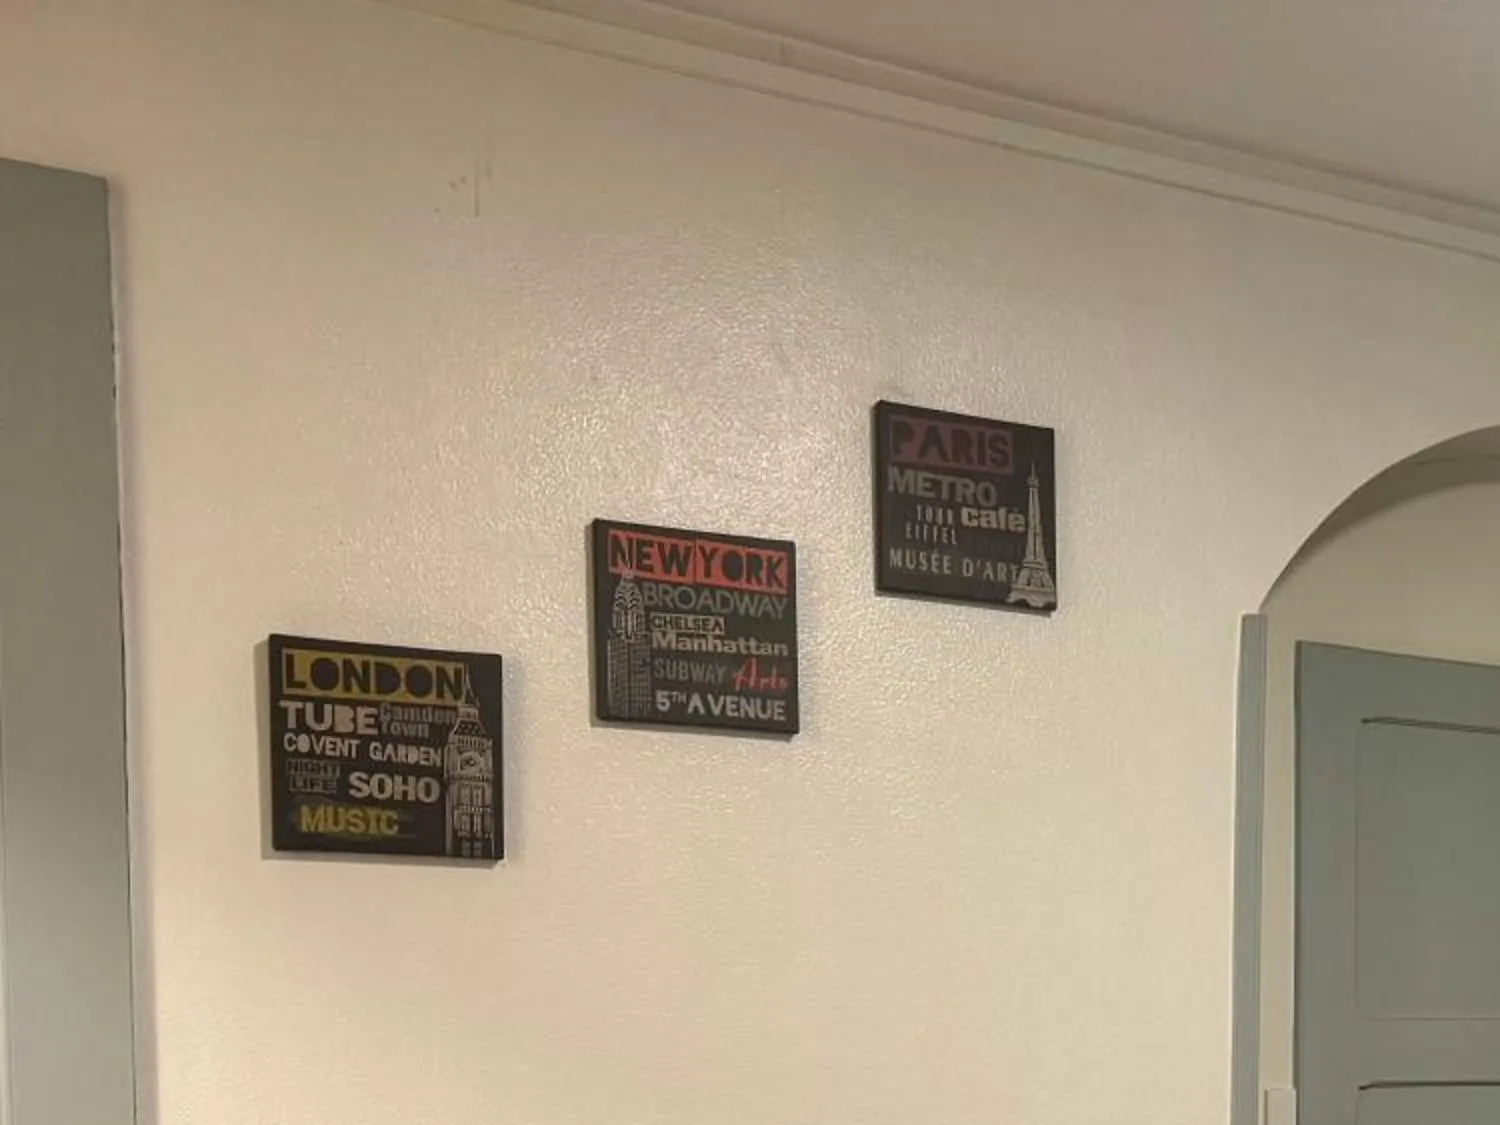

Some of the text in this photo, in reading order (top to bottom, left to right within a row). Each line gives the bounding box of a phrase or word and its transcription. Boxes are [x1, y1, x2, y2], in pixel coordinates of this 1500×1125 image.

[893, 420, 1010, 468] PARIS
[888, 465, 999, 507] METRO
[917, 505, 954, 527] TOUR
[906, 522, 958, 546] EIFFEL
[610, 534, 785, 588] NEW YORK
[962, 558, 1020, 583] D'ART
[642, 583, 787, 620] BROADWAY
[651, 614, 724, 633] CHELSEA
[652, 631, 789, 657] Manhattan
[285, 653, 463, 700] LONDON
[653, 657, 789, 692] SUBWAY Arts
[279, 700, 379, 735] TUBE
[380, 702, 458, 725] Camden
[655, 690, 787, 721] 5TH AVENUE
[380, 720, 430, 738] Town
[283, 732, 443, 768] COVENT GARDEN
[286, 757, 341, 778] NIGHT
[289, 776, 338, 795] LIFE
[348, 771, 441, 803] SOHO
[301, 805, 400, 834] MUSIC
